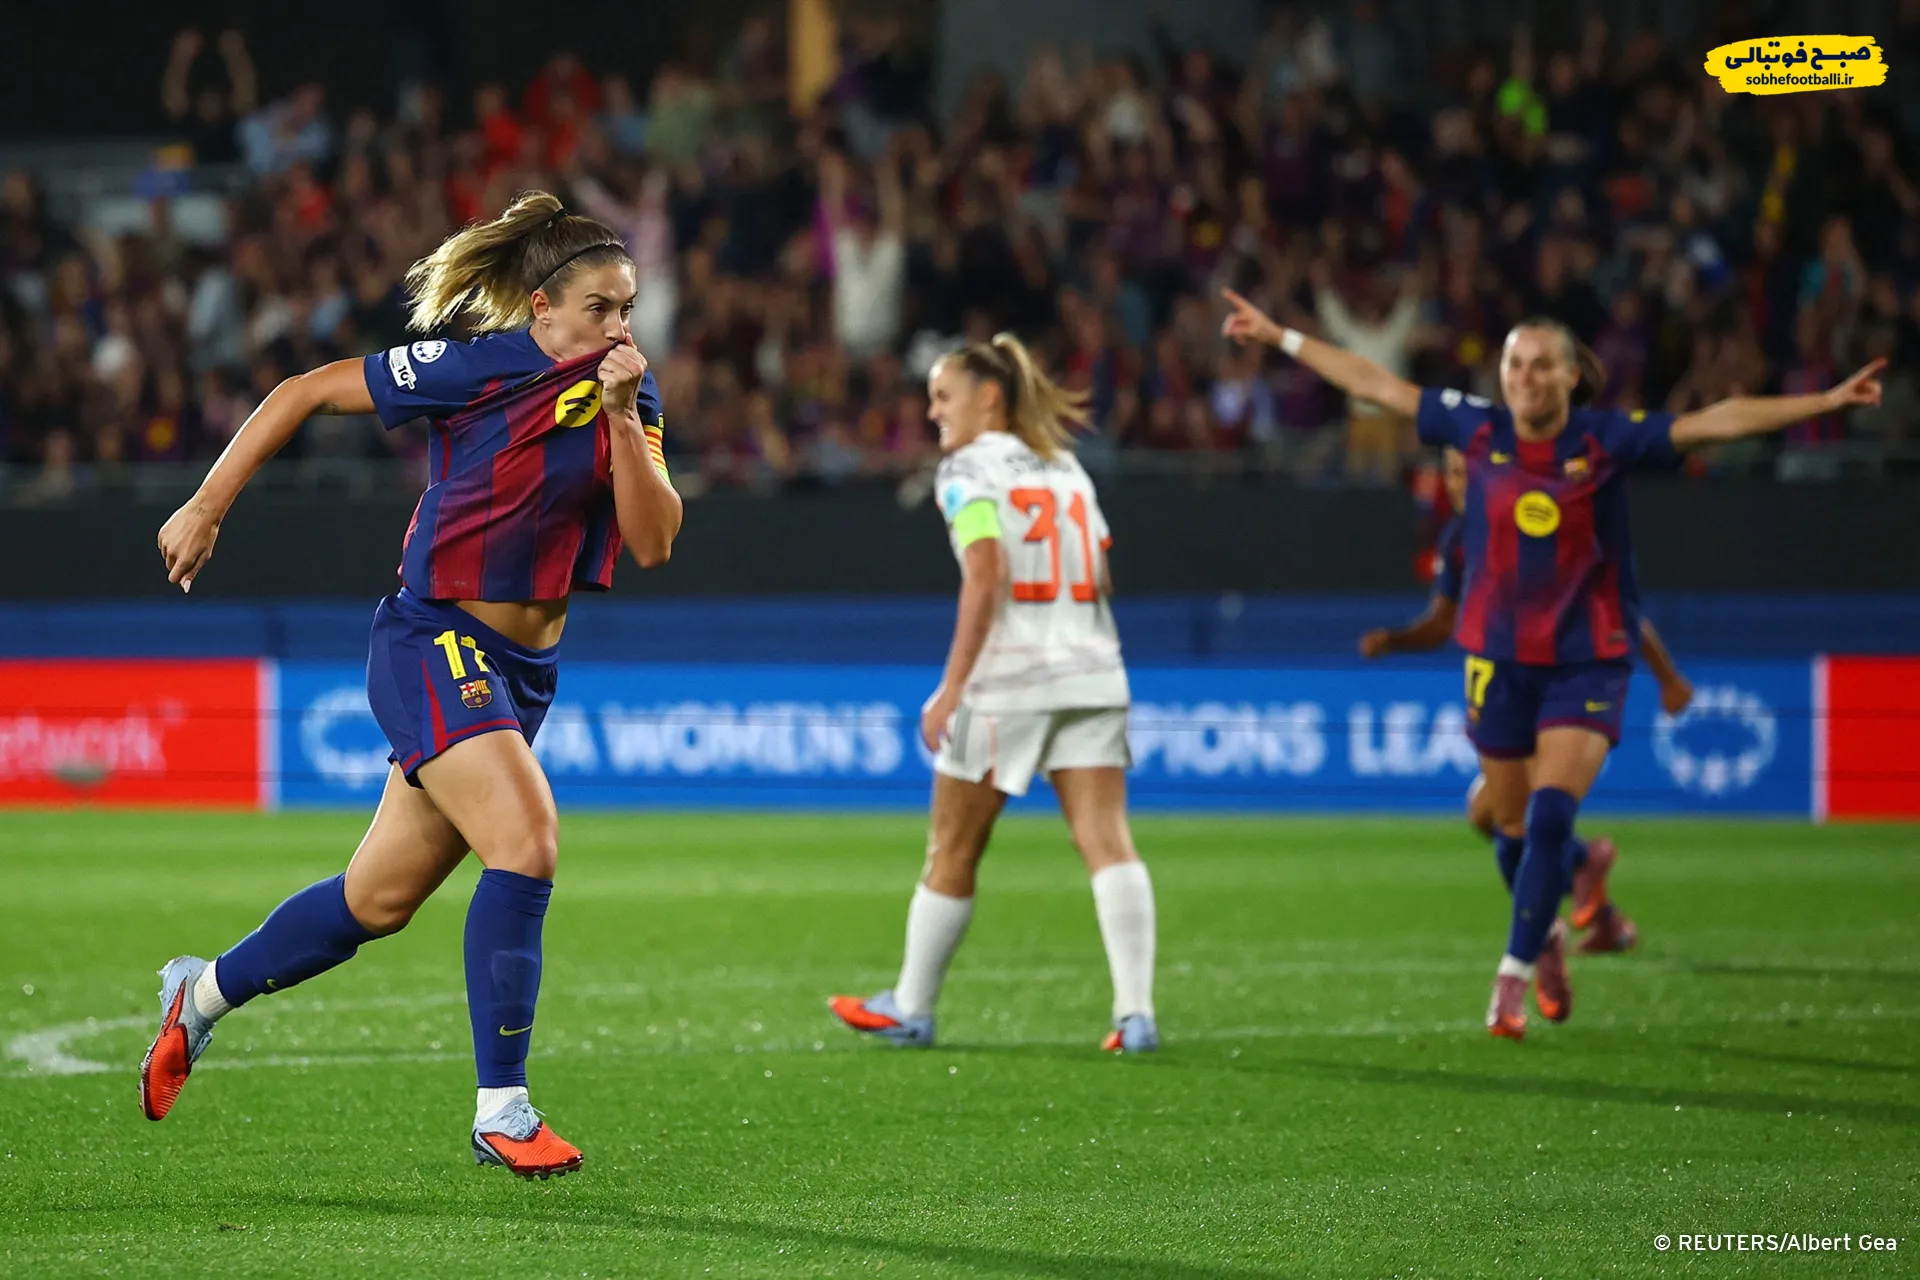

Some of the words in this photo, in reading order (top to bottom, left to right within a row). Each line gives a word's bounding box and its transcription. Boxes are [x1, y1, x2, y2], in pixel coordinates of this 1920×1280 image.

[1009, 487, 1098, 603] 31
[1127, 703, 1327, 776] PIONS
[1349, 703, 1480, 775] LEA
